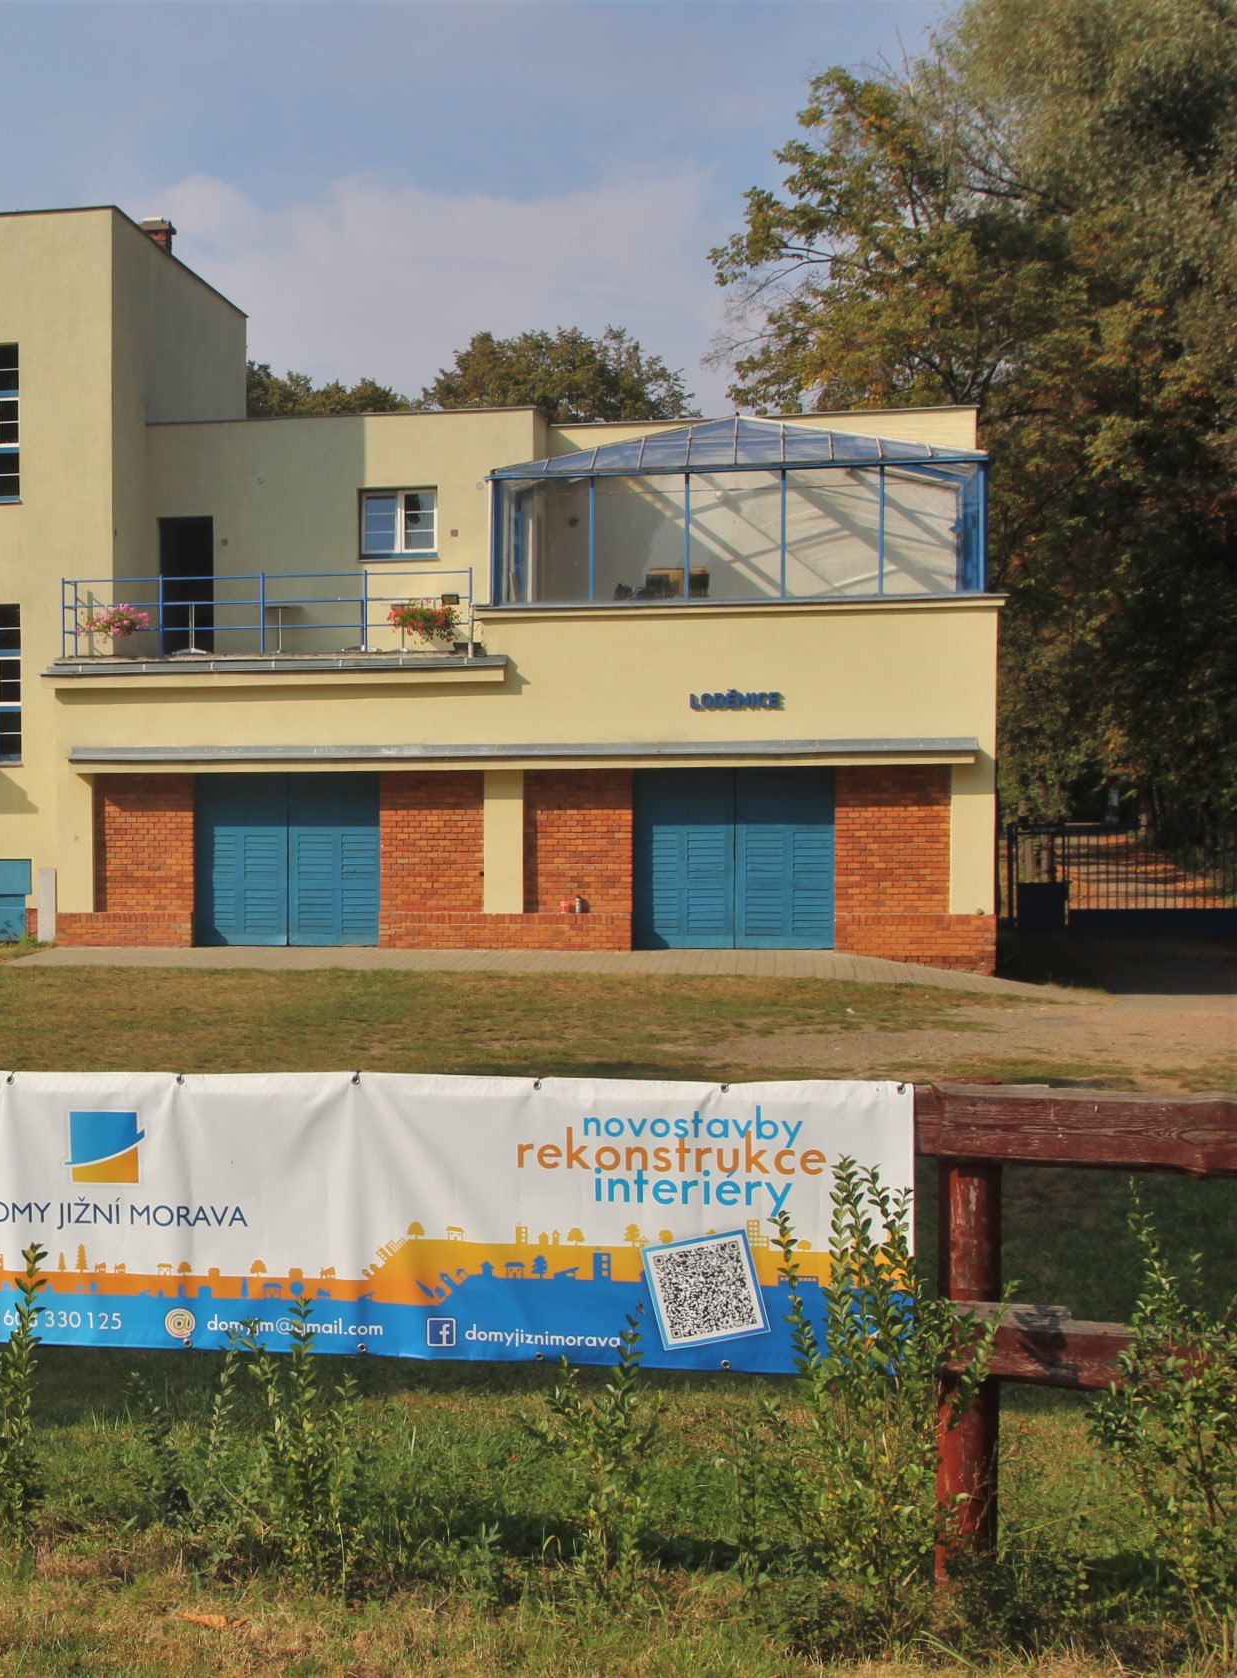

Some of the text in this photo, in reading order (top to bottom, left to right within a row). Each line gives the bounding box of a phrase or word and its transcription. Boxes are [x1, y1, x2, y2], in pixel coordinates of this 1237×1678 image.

[689, 689, 782, 708] LODĚNICE
[583, 1105, 803, 1149] novostavby
[517, 1126, 827, 1175] rekonstrukce
[594, 1167, 793, 1217] interiéry
[57, 1196, 121, 1230] JIŽNÍ
[130, 1204, 248, 1227] MORAVA
[44, 1311, 81, 1329] 330
[87, 1312, 122, 1330] 125
[465, 1324, 621, 1348] domyjiznimorava
